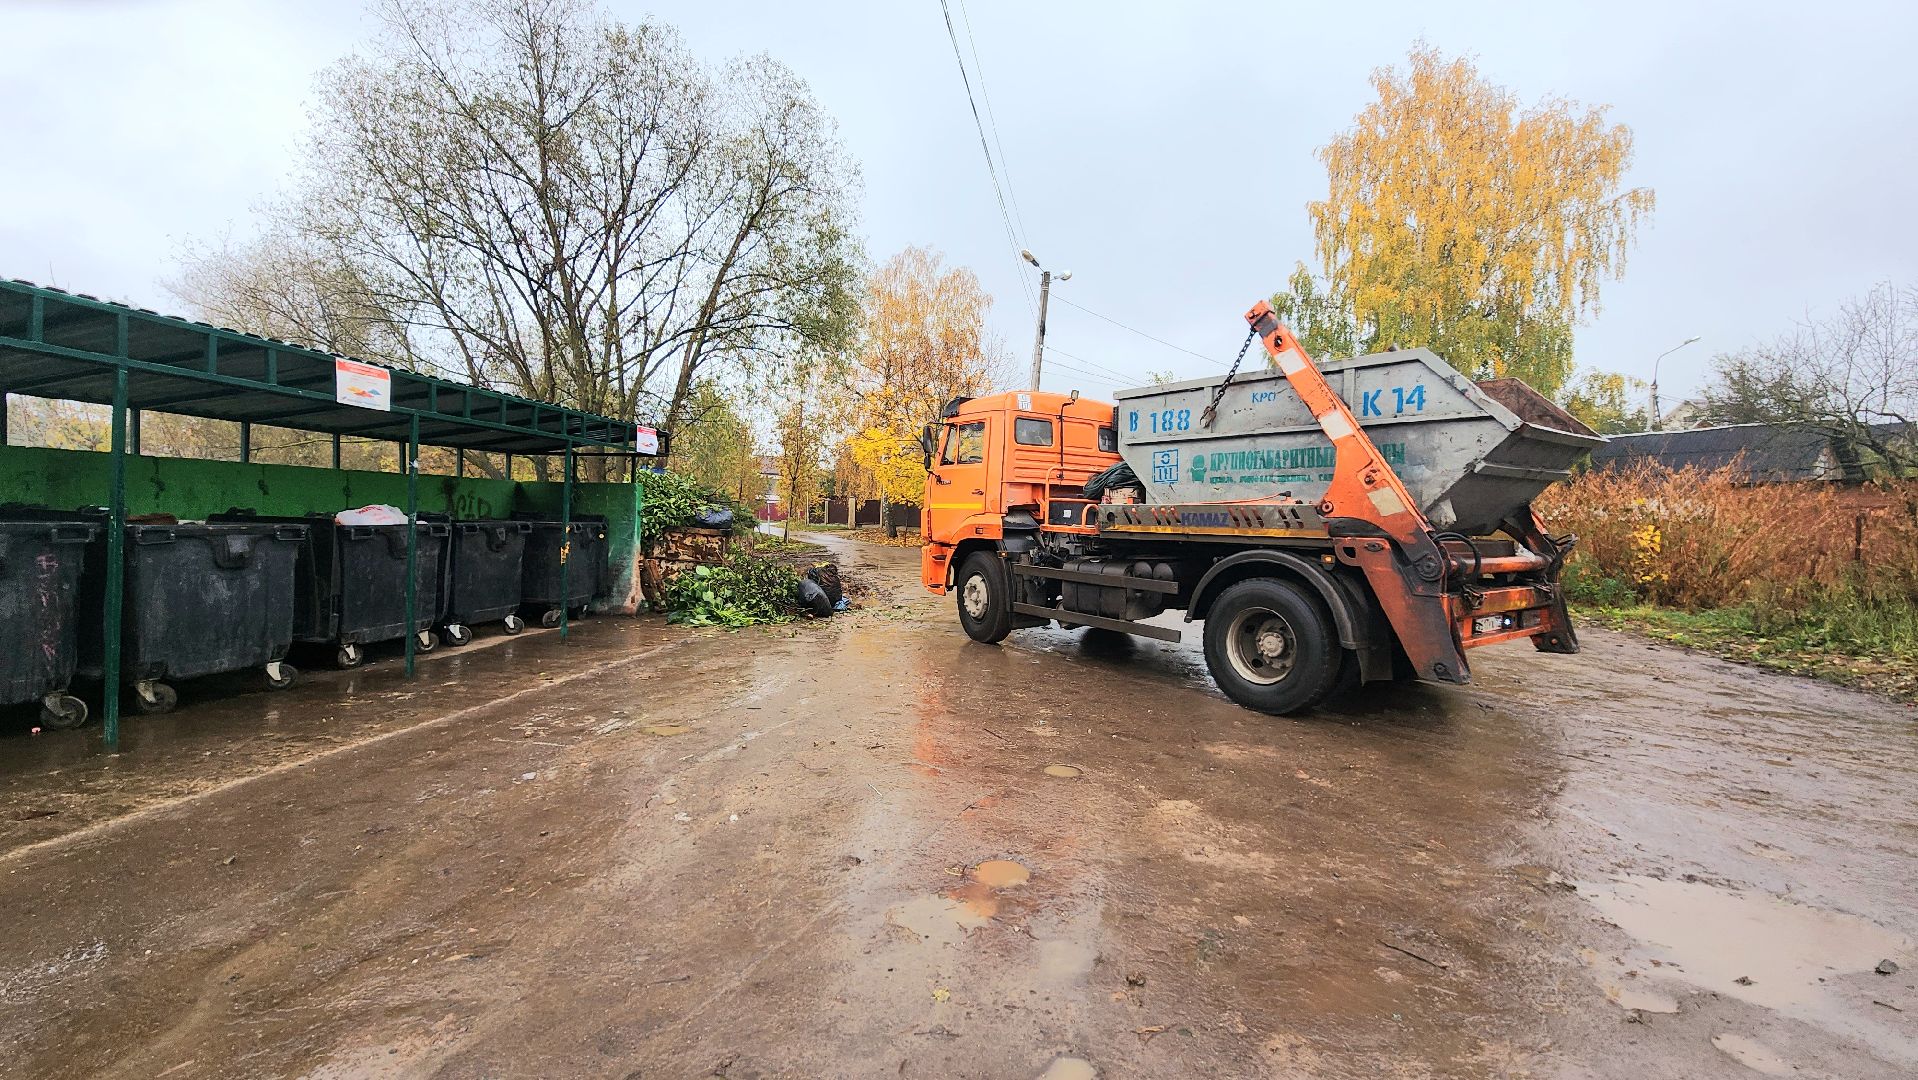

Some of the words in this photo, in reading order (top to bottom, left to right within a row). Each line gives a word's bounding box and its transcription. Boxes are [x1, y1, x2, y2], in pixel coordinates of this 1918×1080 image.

[1391, 384, 1425, 413] 14
[1150, 409, 1191, 433] 188
[1181, 512, 1229, 527] KAMAZ
